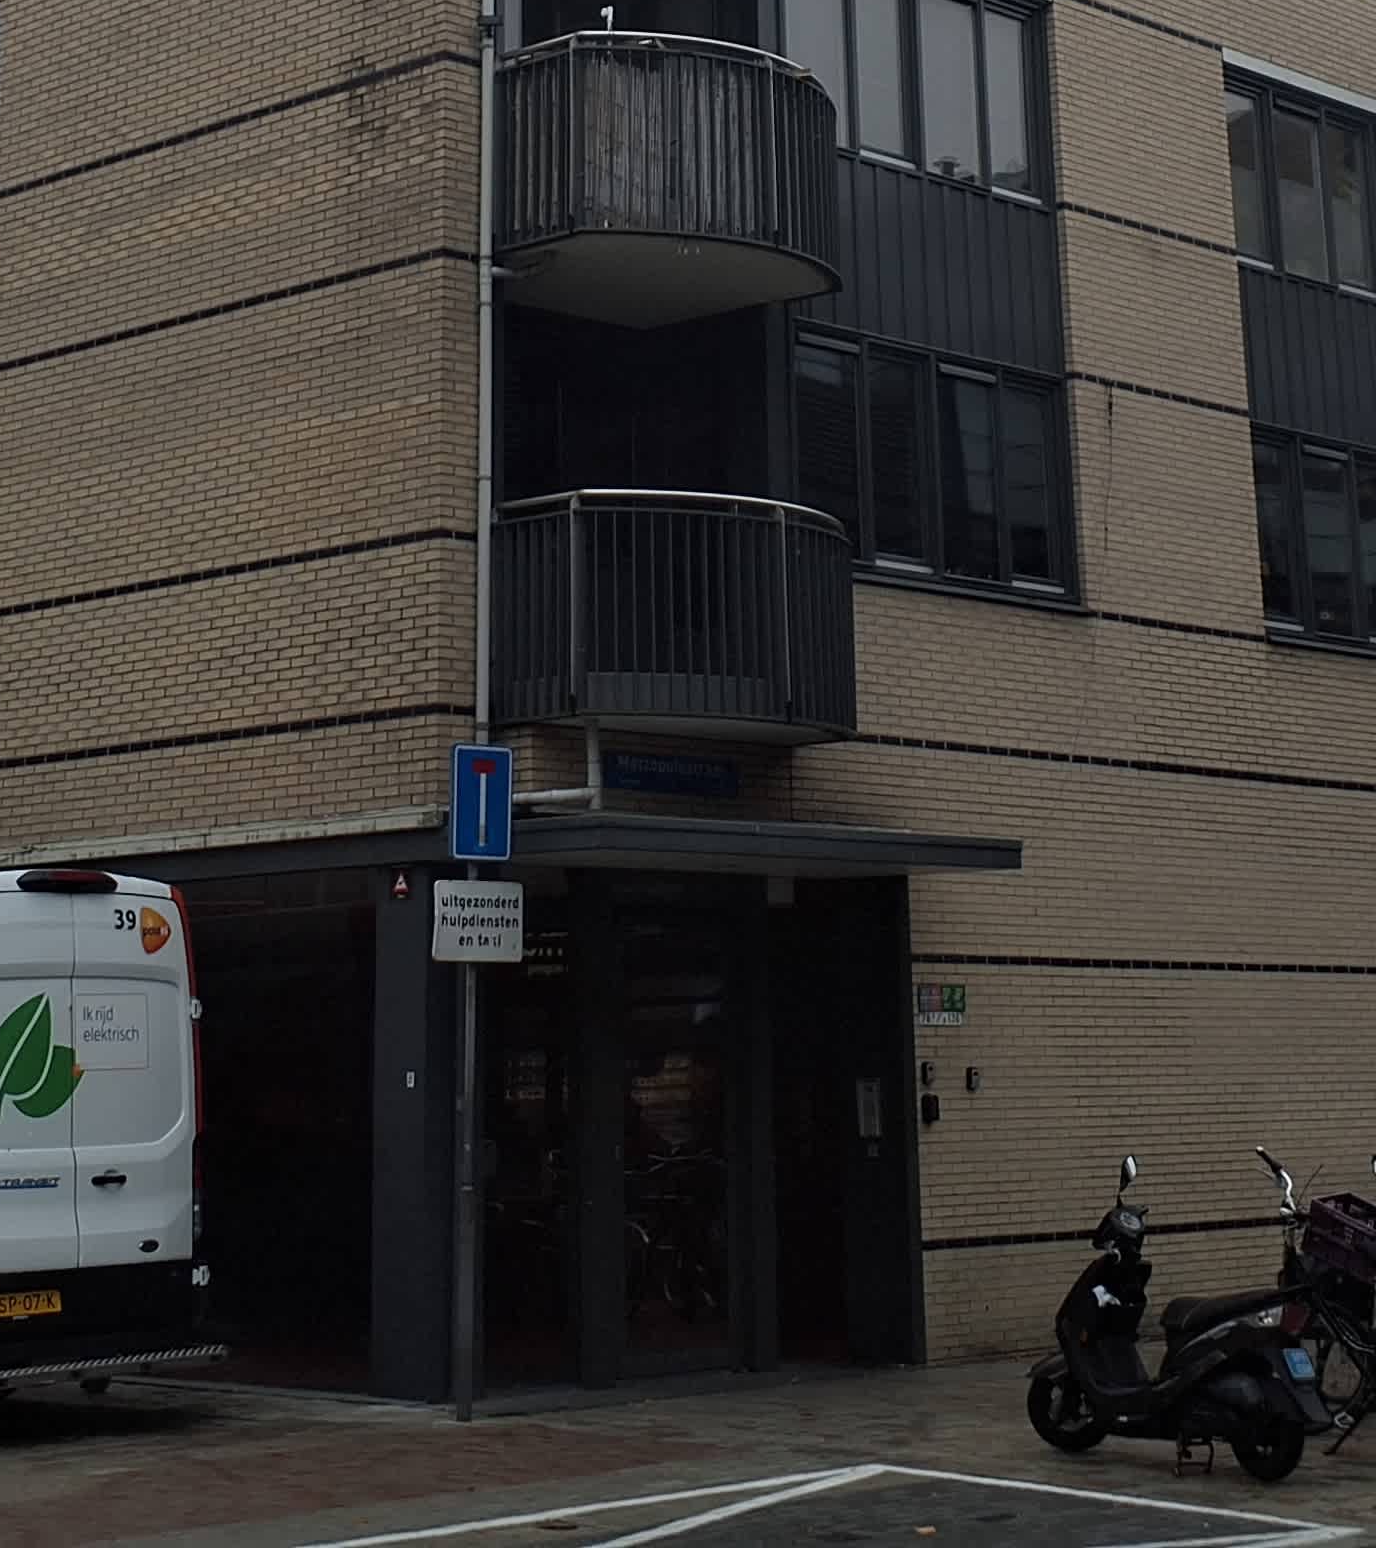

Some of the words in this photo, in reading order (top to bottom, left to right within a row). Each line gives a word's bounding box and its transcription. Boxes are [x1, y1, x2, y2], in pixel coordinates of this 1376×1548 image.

[441, 894, 519, 910] uitgezonderd
[114, 909, 136, 930] 39
[441, 914, 519, 929] hulpdiensten
[458, 935, 473, 947] en
[83, 1006, 94, 1021] Ik
[95, 1005, 114, 1026] rijd
[83, 1026, 140, 1042] elektrisch
